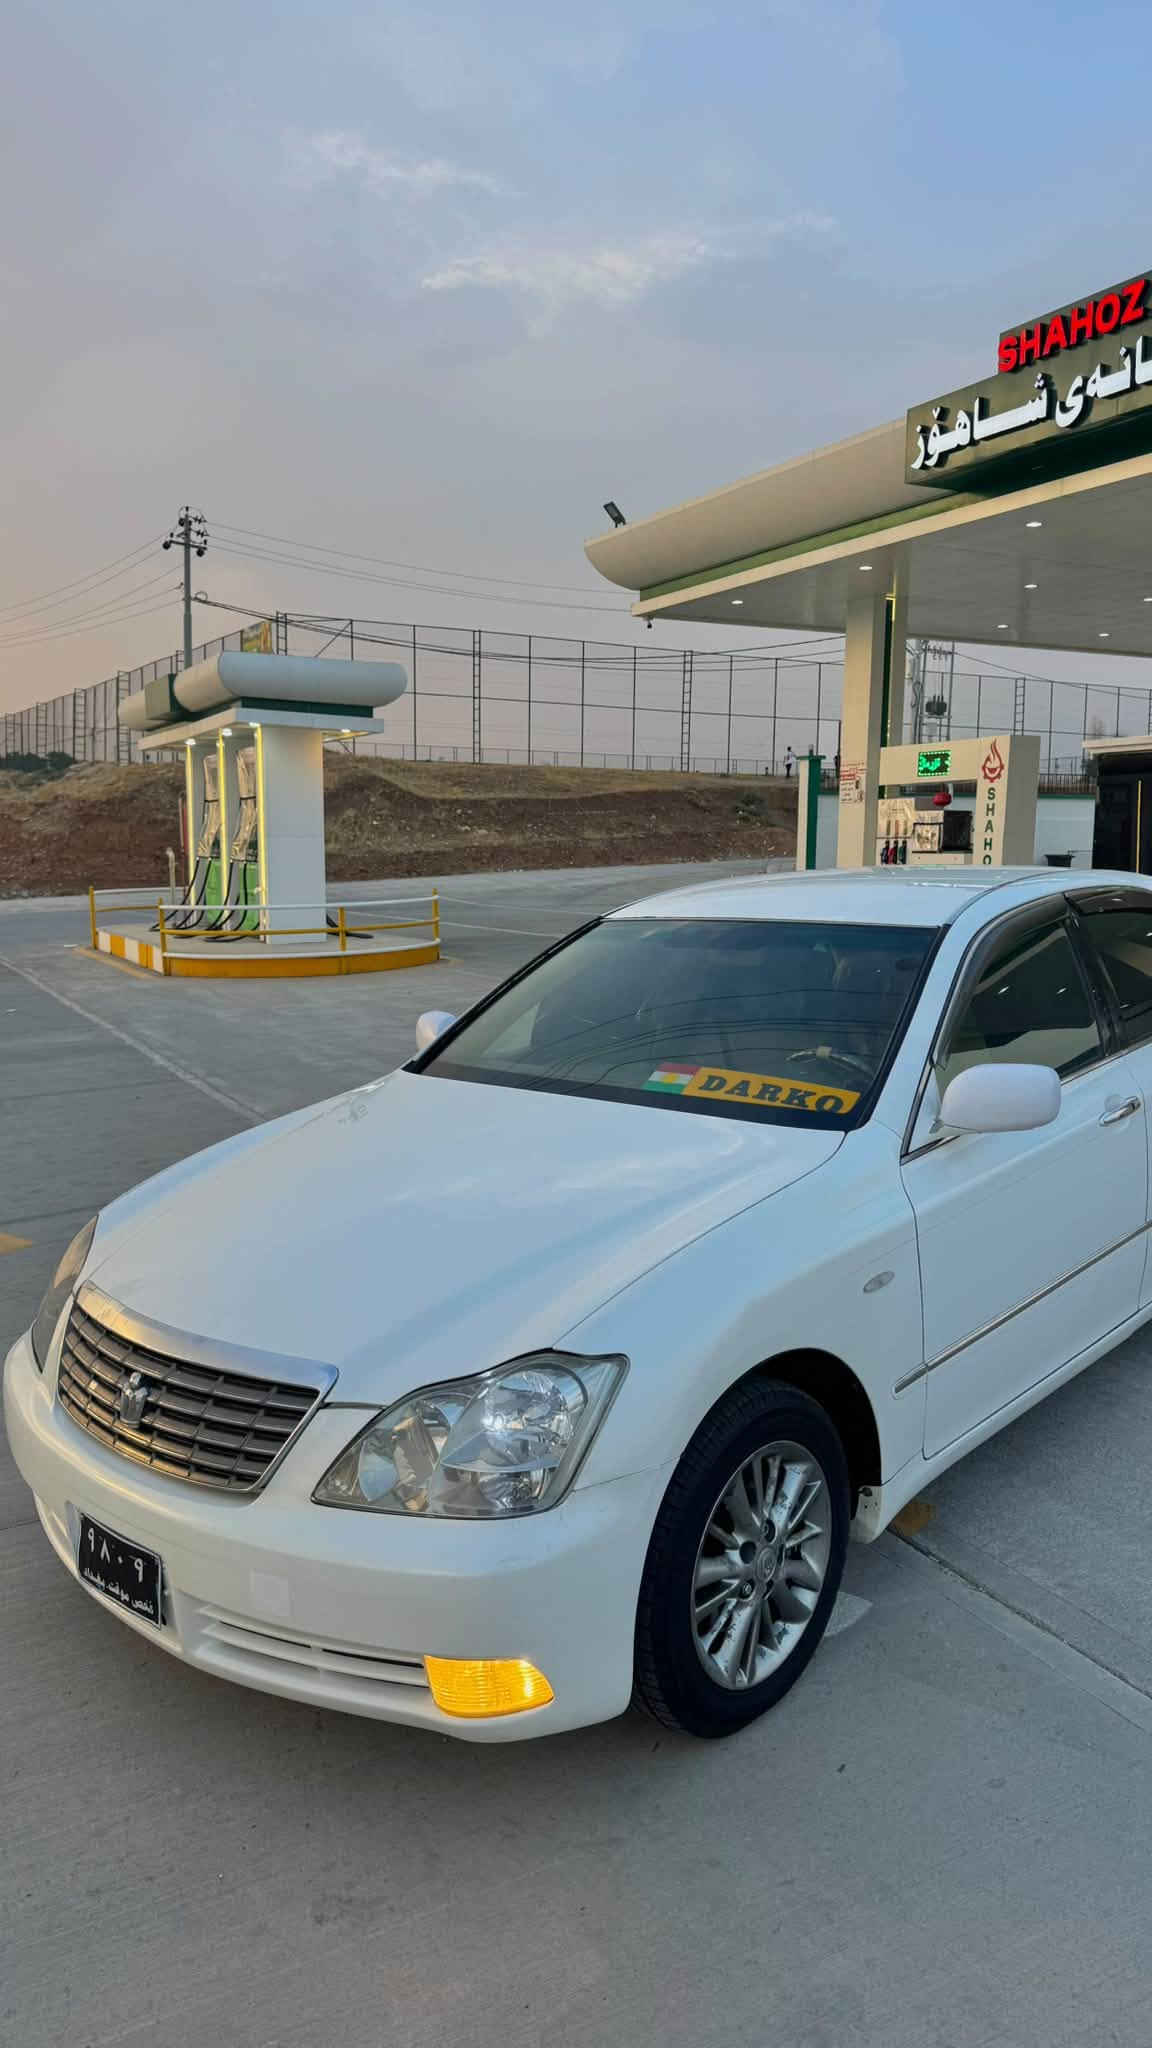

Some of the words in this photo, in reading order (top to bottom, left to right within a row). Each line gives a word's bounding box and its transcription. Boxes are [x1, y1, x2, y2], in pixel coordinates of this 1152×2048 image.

[998, 279, 1146, 373] SHAHOZ
[698, 1075, 845, 1114] DARKO
[87, 1528, 144, 1583] ٩٨٠٩
